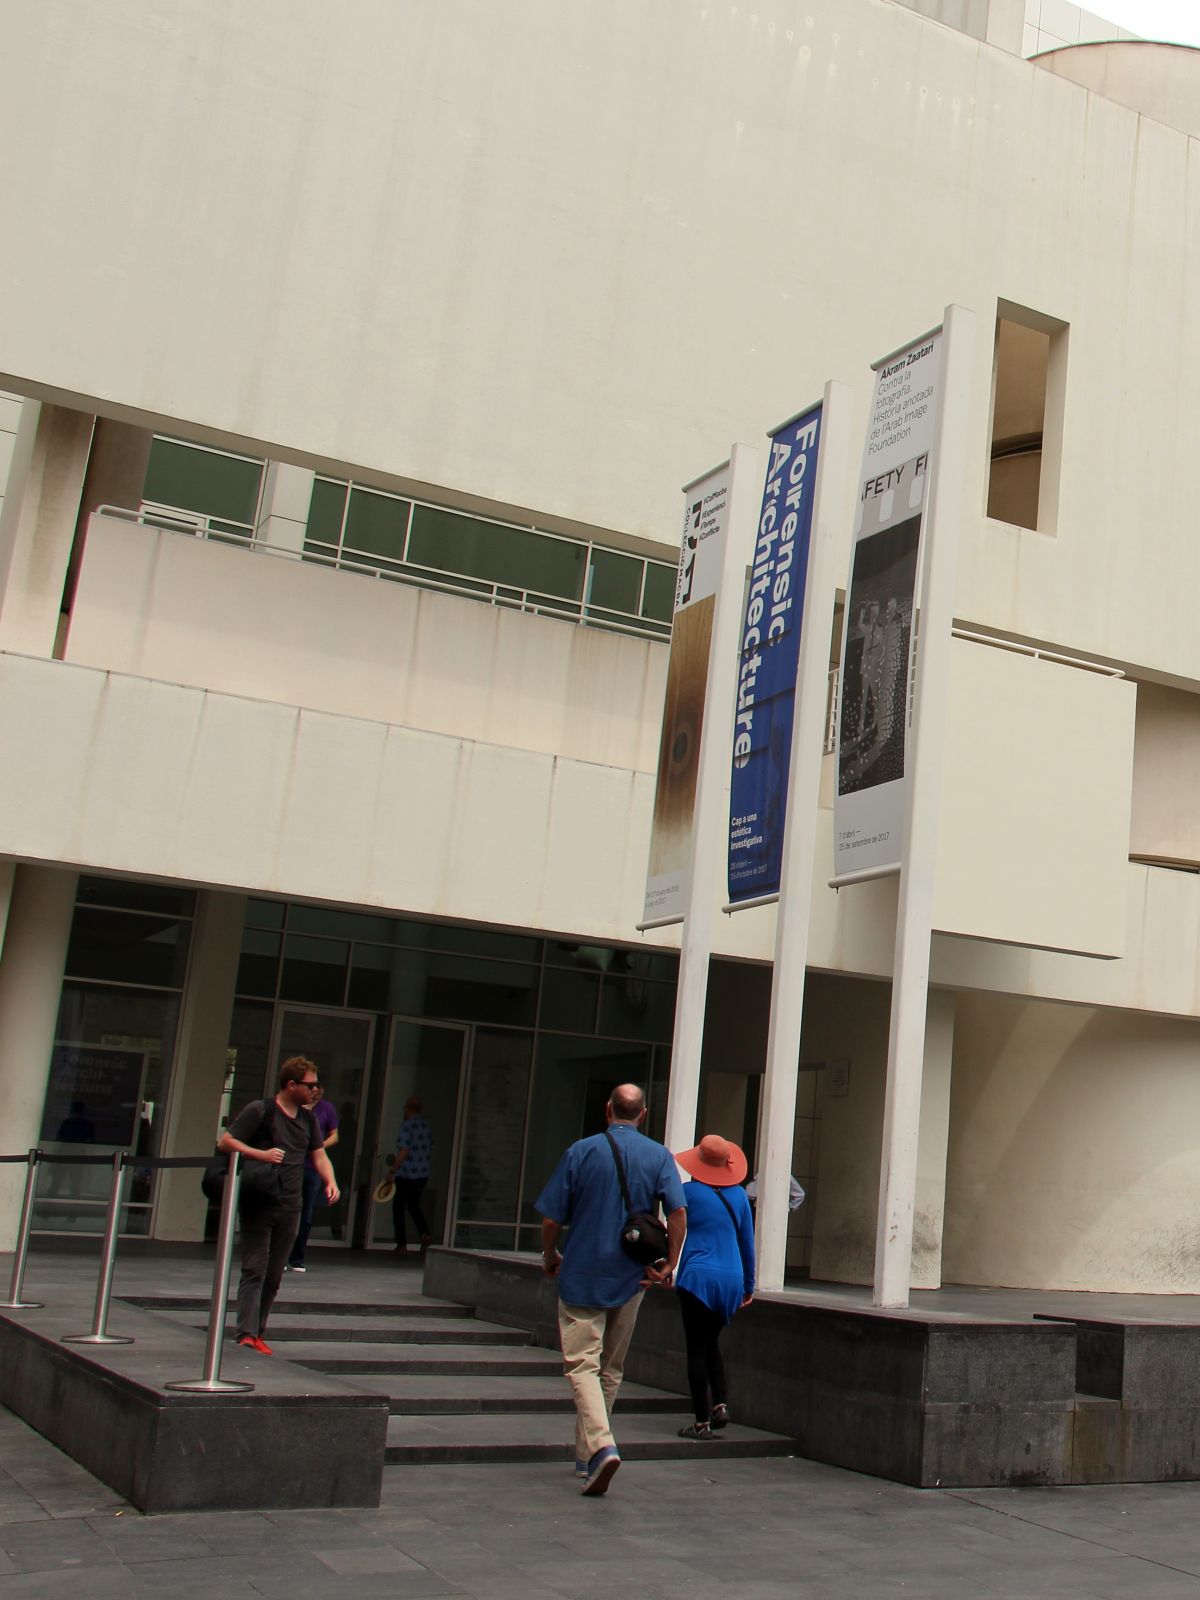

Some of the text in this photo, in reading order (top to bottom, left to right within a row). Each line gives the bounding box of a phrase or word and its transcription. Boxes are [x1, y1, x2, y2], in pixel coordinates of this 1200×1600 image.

[880, 341, 934, 380] Akram Zaatari
[877, 369, 912, 396] Contra la
[902, 385, 934, 410] anotada
[870, 427, 880, 440] de
[904, 404, 928, 424] Image
[868, 427, 912, 455] Foundation
[861, 465, 905, 502] FETY
[768, 418, 818, 646] Forensic
[734, 442, 792, 769] Architecture
[731, 817, 743, 827] Cap
[747, 813, 758, 822] una
